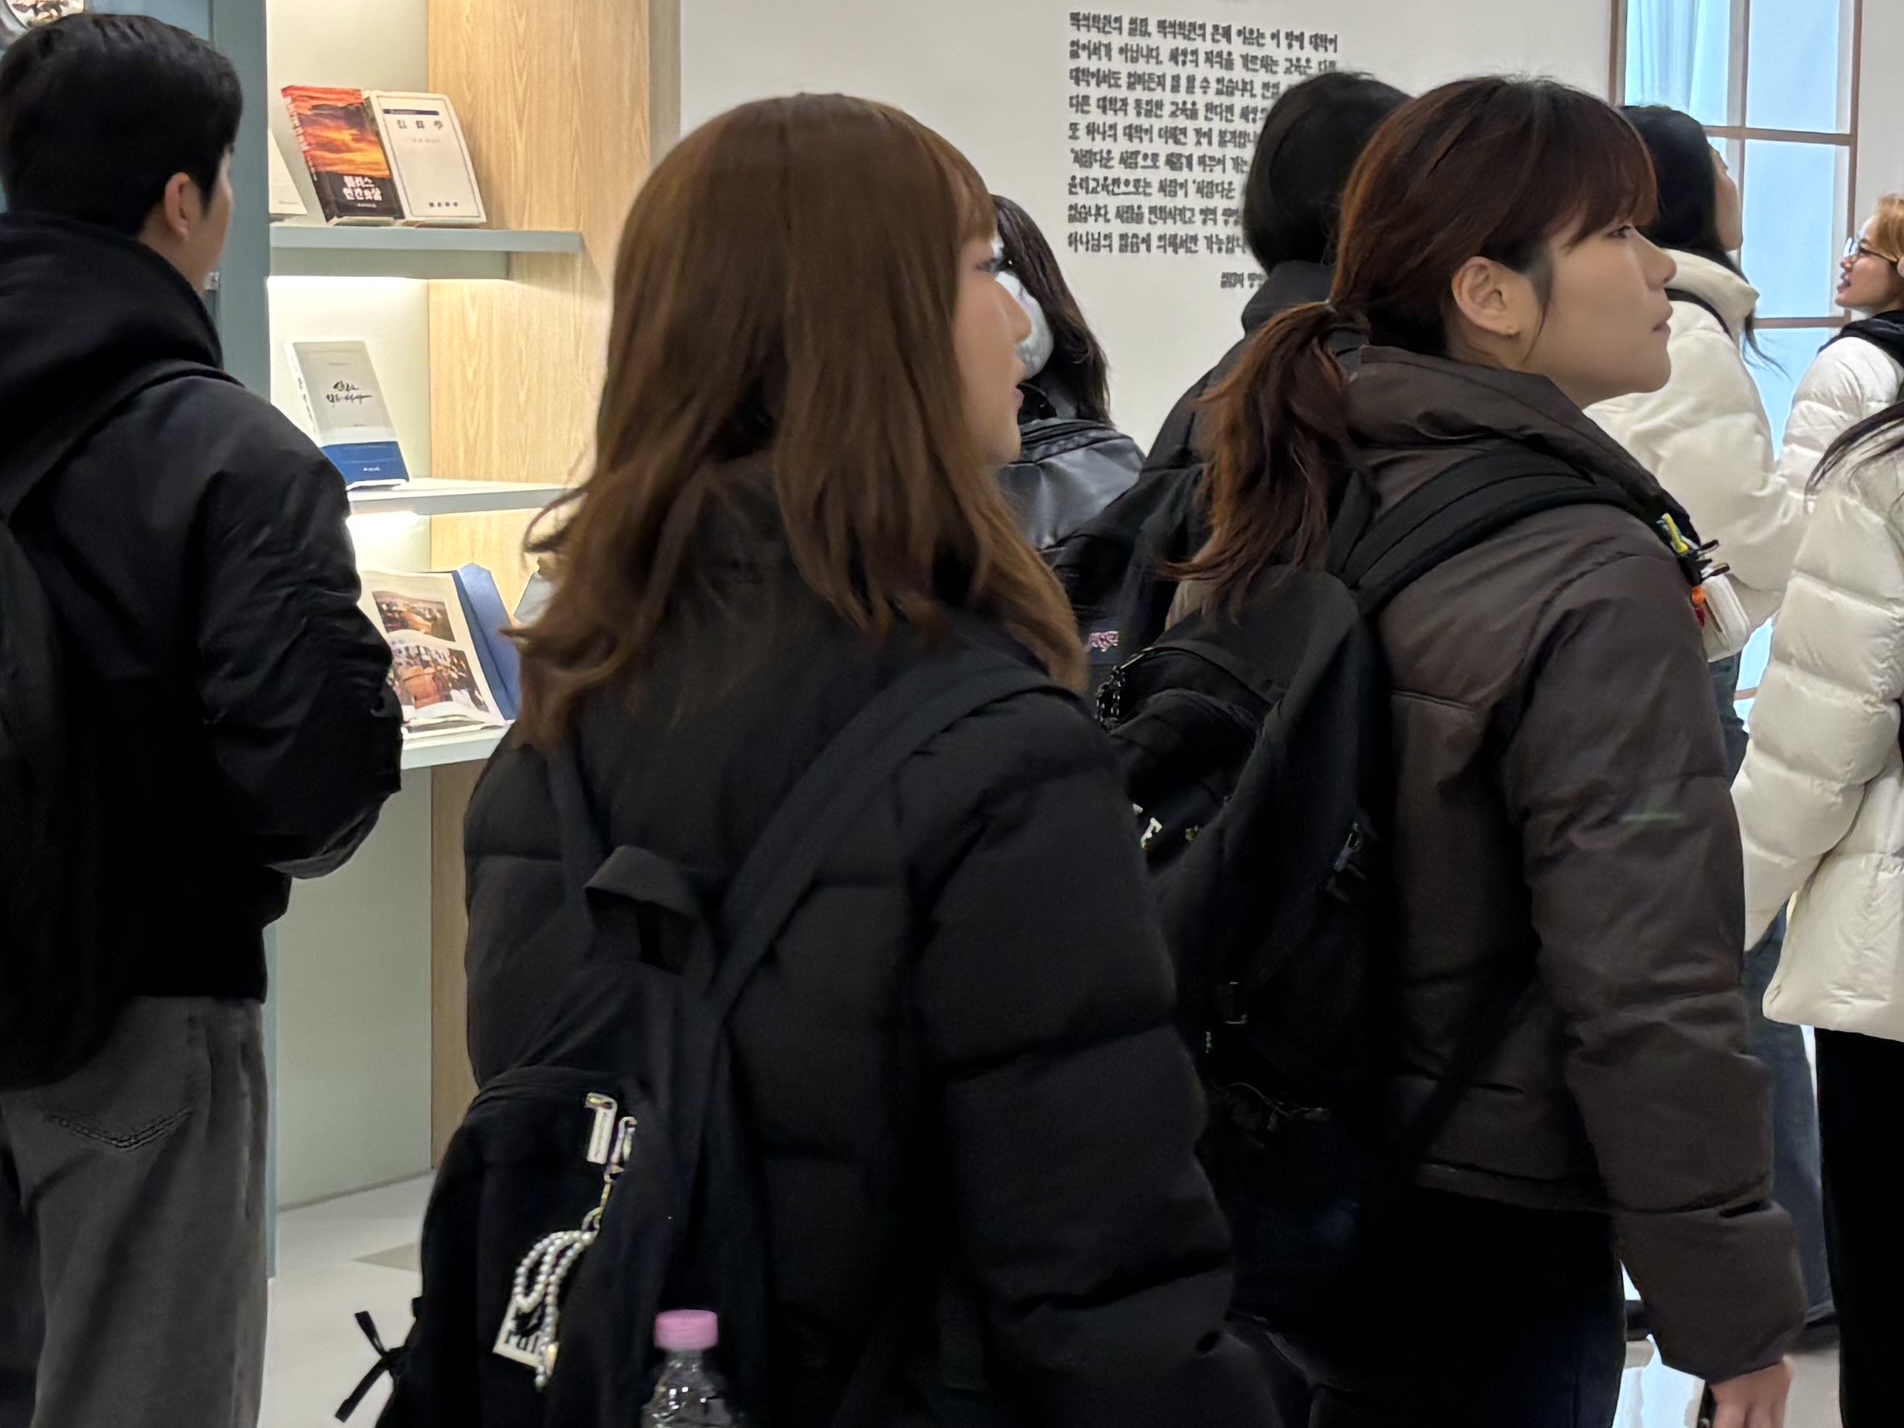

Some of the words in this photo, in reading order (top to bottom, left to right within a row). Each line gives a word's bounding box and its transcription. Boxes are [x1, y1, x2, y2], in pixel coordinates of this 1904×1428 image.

[1069, 11, 1123, 36] 백석학원의
[1157, 19, 1206, 43] 백석학원의
[1270, 29, 1281, 49] 이
[1309, 32, 1338, 54] 대학이
[1118, 42, 1163, 65] 아닙니다.
[1168, 46, 1199, 69] 세상의
[1069, 66, 1123, 89] 대학에서도
[1199, 76, 1211, 95] 수
[1215, 76, 1257, 98] 있습니다.
[1069, 94, 1091, 115] 다른
[1096, 95, 1129, 117] 대학과
[1134, 98, 1164, 119] 동일한
[1169, 100, 1199, 121] 교육을
[1204, 101, 1234, 123] 한다면
[1068, 122, 1080, 141] 또
[1086, 122, 1117, 143] 하나의
[1123, 123, 1153, 144] 대학이
[1193, 127, 1213, 147] 것에
[1218, 129, 1258, 149] 불과합니
[1158, 178, 1189, 199] 사람이
[1067, 203, 1111, 224] 없습니다.
[1115, 204, 1144, 225] 사람을
[1067, 231, 1113, 254] 하나님의
[1118, 232, 1151, 254] 말씀에
[1156, 233, 1199, 255] 의해서만
[1204, 234, 1246, 255] 가능합니
